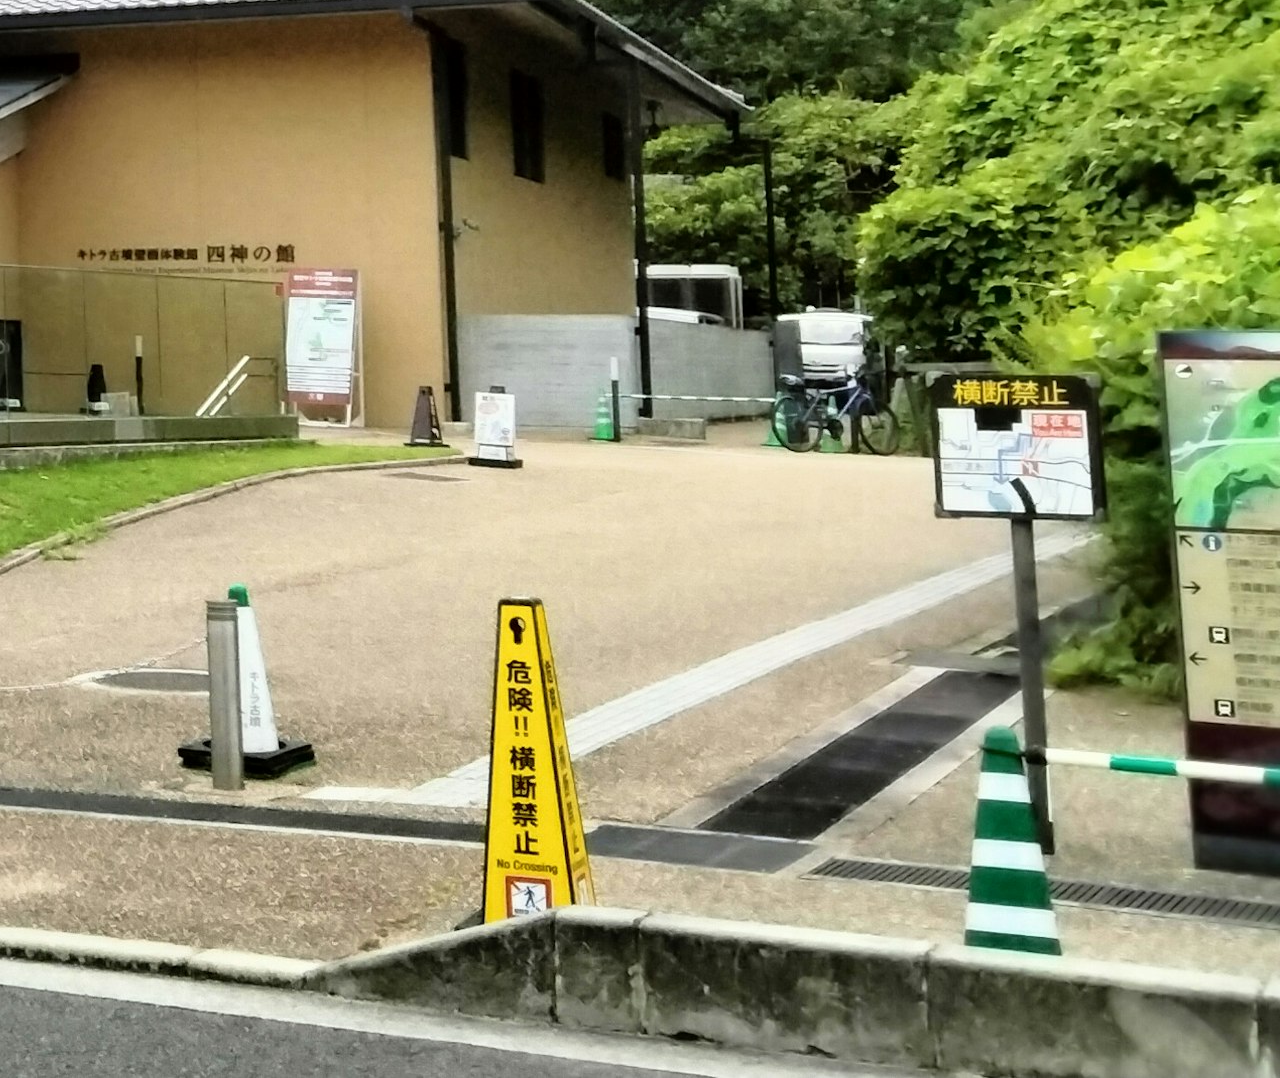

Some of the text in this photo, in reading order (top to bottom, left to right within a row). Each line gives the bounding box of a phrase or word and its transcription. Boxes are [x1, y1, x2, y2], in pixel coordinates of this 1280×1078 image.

[207, 243, 295, 263] 四神の館
[953, 379, 1070, 405] 横断禁止
[506, 660, 539, 856] 危険!!横断禁止
[497, 859, 510, 869] No
[514, 860, 558, 875] Crossing
